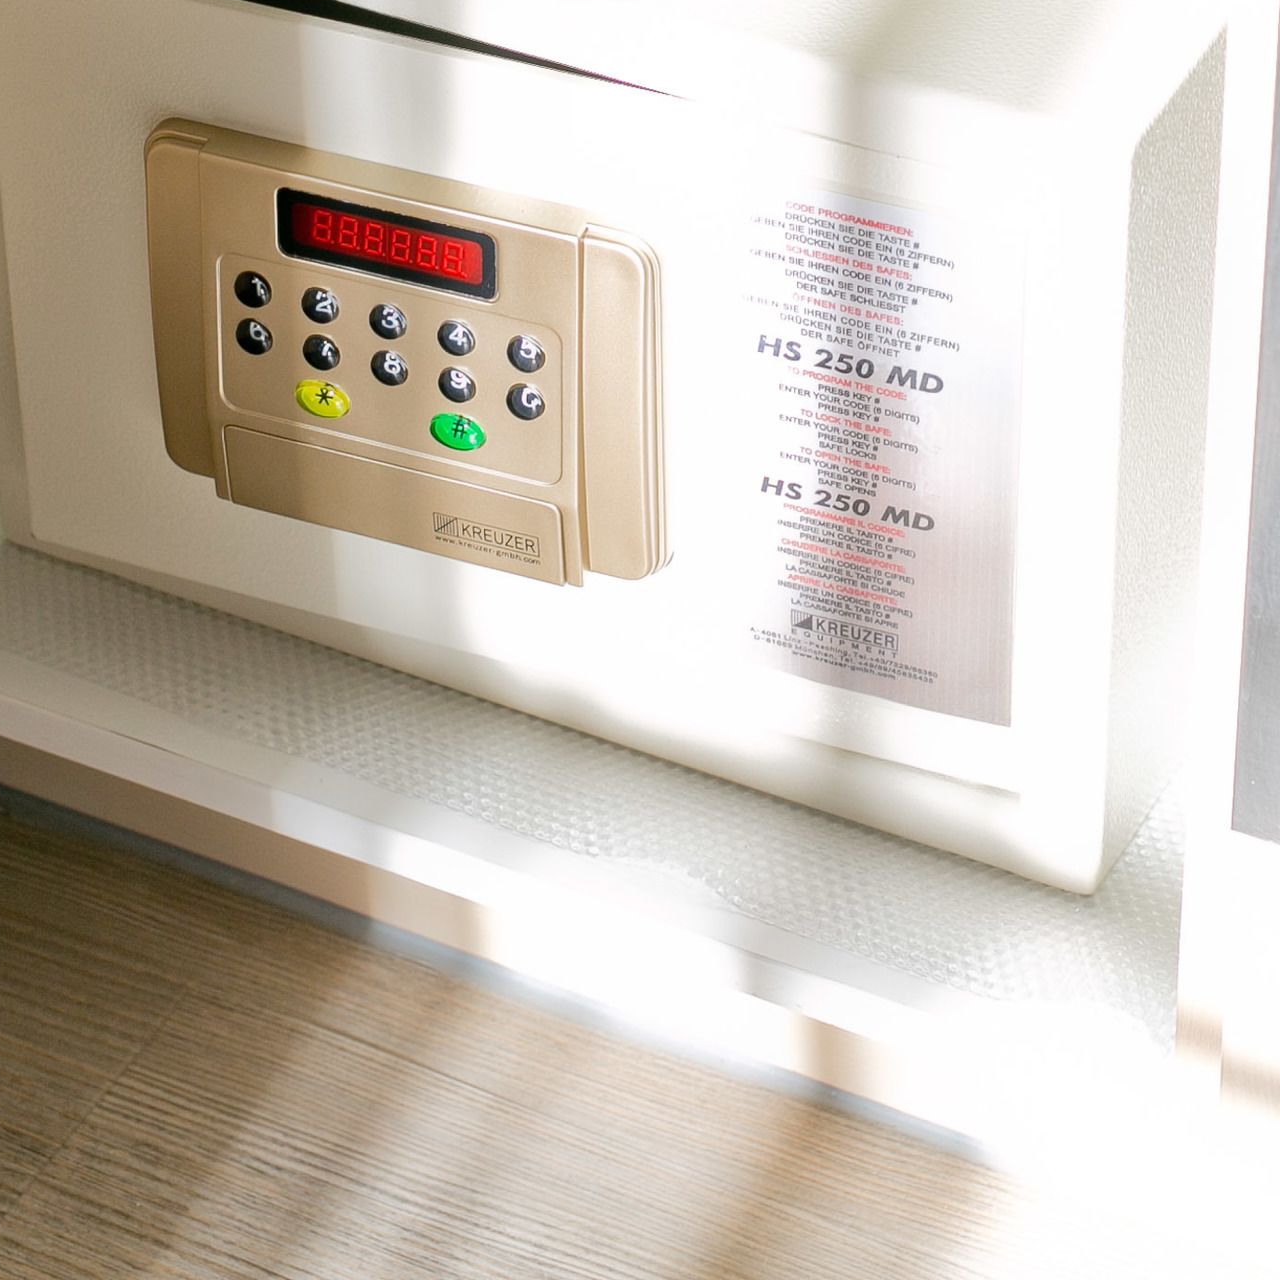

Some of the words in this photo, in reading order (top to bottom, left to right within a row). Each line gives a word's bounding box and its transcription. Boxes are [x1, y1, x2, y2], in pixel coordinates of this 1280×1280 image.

[784, 212, 835, 231] DRÜCKEN
[838, 224, 854, 236] SIE
[858, 228, 875, 240] DIE
[878, 233, 910, 248] TASTE
[785, 200, 814, 214] CODE
[817, 207, 913, 237] PROGRAMMIEREN:
[784, 232, 834, 251] DRÜCKEN
[838, 244, 854, 256] SIE
[857, 248, 874, 260] DIE
[878, 253, 910, 268] TASTE
[785, 243, 848, 266] SCHLIESSEN
[852, 259, 873, 272] DES
[876, 264, 912, 281] SAFES:
[788, 223, 804, 234] SIE
[808, 227, 839, 242] IHREN
[842, 235, 871, 249] CODE
[875, 242, 892, 254] EIN
[895, 246, 904, 258] (6
[907, 249, 955, 269] ZIFFERN)
[784, 268, 834, 287] DRÜCKEN
[837, 280, 854, 292] SIE
[857, 284, 874, 296] DIE
[877, 289, 908, 304] TASTE
[788, 255, 804, 267] SIE
[807, 260, 838, 275] IHREN
[842, 268, 871, 282] CODE
[874, 275, 891, 287] EIN
[894, 279, 904, 291] (6
[906, 282, 953, 302] ZIFFERN)
[791, 291, 835, 311] ÖFFNEN
[839, 304, 860, 316] DES
[865, 310, 903, 326] SAFES:
[796, 280, 817, 293] DER
[820, 286, 846, 300] SAFE
[849, 293, 905, 314] SCHLIESST
[382, 307, 402, 328] 3
[450, 326, 470, 347] 4
[520, 339, 540, 360] 5
[779, 312, 831, 332] DRÜCKEN
[835, 325, 852, 337] SIE
[856, 329, 873, 341] DIE
[878, 334, 911, 350] TASTE
[783, 302, 798, 314] SIE
[803, 307, 836, 323] IHREN
[840, 315, 871, 330] CODE
[874, 323, 892, 335] EIN
[896, 328, 906, 339] (6
[909, 331, 960, 351] ZIFFERN)
[800, 327, 822, 340] DER
[826, 334, 853, 348] SAFE
[857, 339, 900, 358] ÖFFNET
[250, 322, 268, 342] 6
[383, 353, 402, 375] 8
[450, 370, 471, 390] 9
[757, 334, 802, 362] HS
[814, 348, 875, 379] 250
[886, 365, 944, 394] MD
[802, 368, 852, 388] PROGRAM
[854, 381, 873, 393] THE
[876, 386, 907, 401] CODE:
[817, 383, 849, 398] PRESS
[852, 391, 872, 403] KEY
[778, 383, 810, 398] ENTER
[813, 391, 840, 405] YOUR
[842, 398, 870, 412] CODE
[873, 405, 881, 416] (6
[884, 407, 919, 424] DIGITS)
[817, 402, 849, 416] PRESS
[852, 410, 871, 422] KEY
[778, 413, 810, 428] ENTER
[813, 421, 840, 435] YOUR
[842, 428, 870, 442] CODE
[872, 435, 881, 446] (6
[883, 437, 919, 454] DIGITS)
[800, 408, 812, 418] TO
[814, 411, 841, 425] LOCK
[843, 418, 861, 430] THE
[864, 423, 892, 437] SAFE:
[817, 432, 848, 446] PRESS
[851, 439, 871, 451] KEY
[818, 440, 843, 453] SAFE
[845, 446, 876, 461] LOCKS
[779, 450, 810, 466] ENTER
[812, 458, 839, 472] YOUR
[841, 465, 868, 479] CODE
[871, 472, 879, 482] (6
[881, 474, 916, 491] DIGITS)
[799, 445, 812, 456] TO
[814, 449, 840, 462] OPEN
[843, 456, 860, 467] THE
[863, 460, 891, 474] SAFE:
[817, 468, 847, 483] PRESS
[851, 476, 870, 488] KEY
[817, 477, 842, 490] SAFE
[844, 483, 876, 497] OPENS
[760, 476, 803, 500] HS
[813, 489, 871, 517] 250
[880, 505, 935, 531] MD
[461, 523, 536, 554] KREUZER
[799, 515, 844, 532] PREMERE
[846, 526, 854, 535] IL
[857, 528, 885, 542] TASTO
[434, 536, 541, 566] www.kreuzer-gmbh.com
[791, 628, 898, 659] EQUIPMENT
[816, 618, 895, 648] KREUZER
